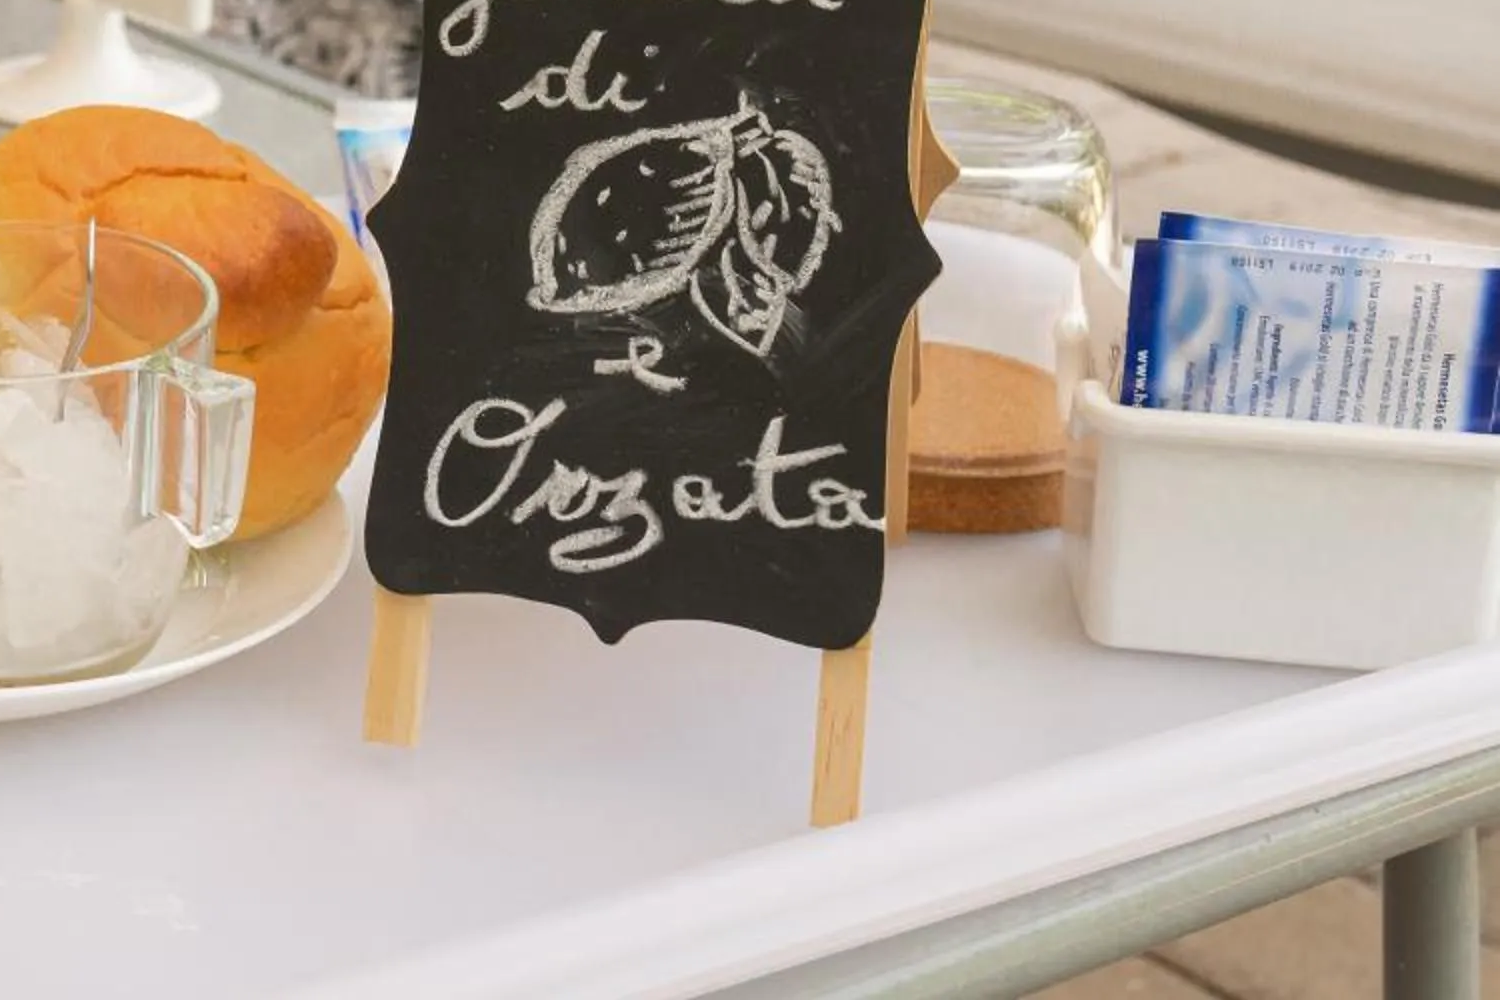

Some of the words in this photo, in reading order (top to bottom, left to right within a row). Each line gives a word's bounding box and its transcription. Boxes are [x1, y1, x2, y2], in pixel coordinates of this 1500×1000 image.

[500, 29, 661, 112] di
[593, 334, 687, 391] e
[424, 399, 887, 573] Orzata
